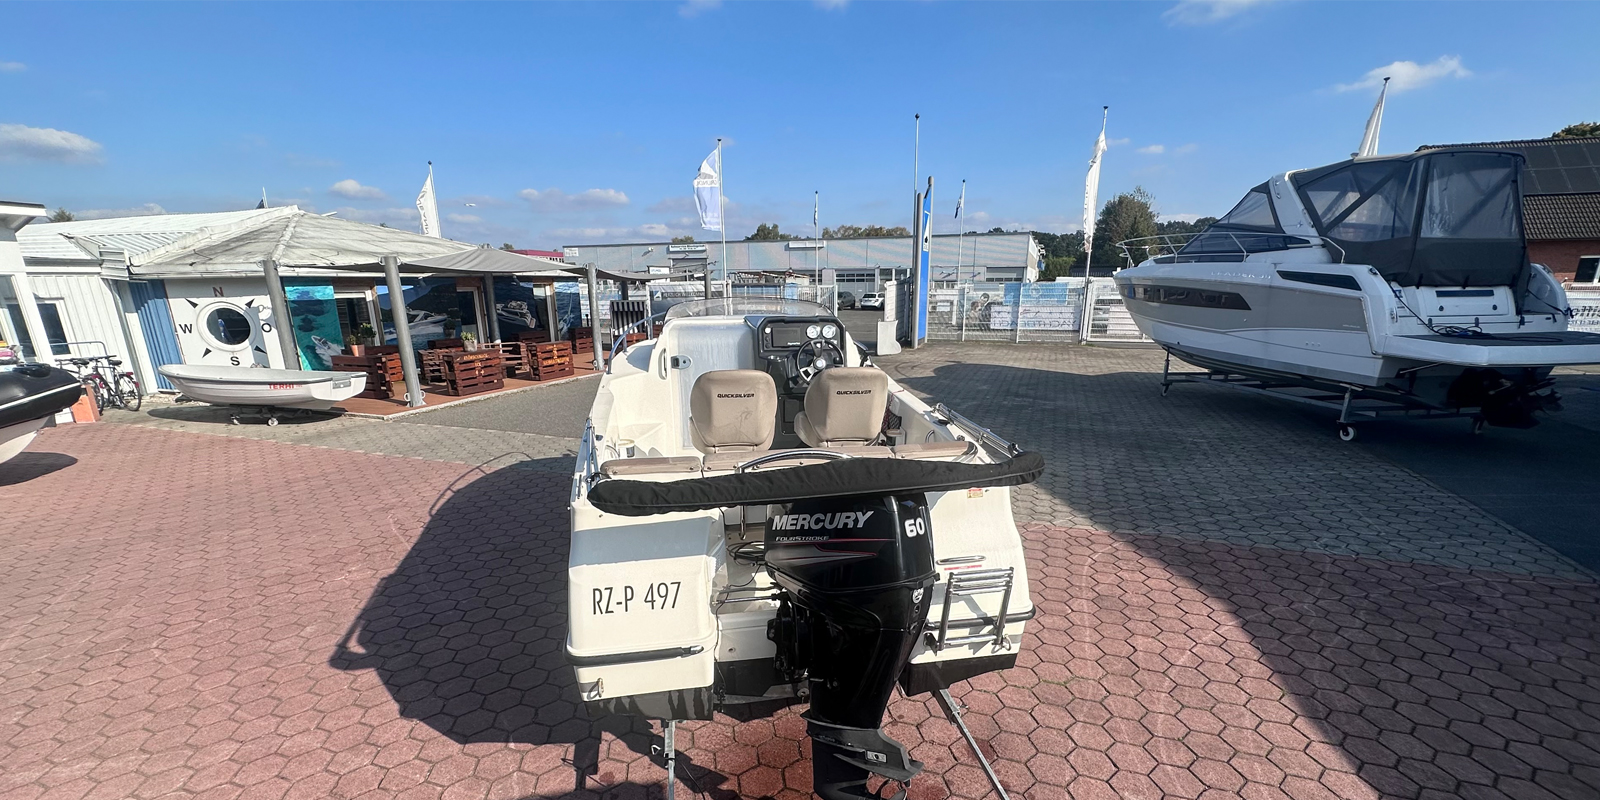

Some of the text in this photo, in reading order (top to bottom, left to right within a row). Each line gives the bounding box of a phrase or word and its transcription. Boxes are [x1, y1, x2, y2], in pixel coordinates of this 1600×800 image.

[212, 286, 224, 297] N
[179, 323, 193, 334] W
[261, 322, 272, 333] O
[230, 355, 241, 366] S
[771, 510, 875, 531] MERCURY
[904, 517, 926, 538] 60
[592, 581, 681, 615] RZ-P 497
